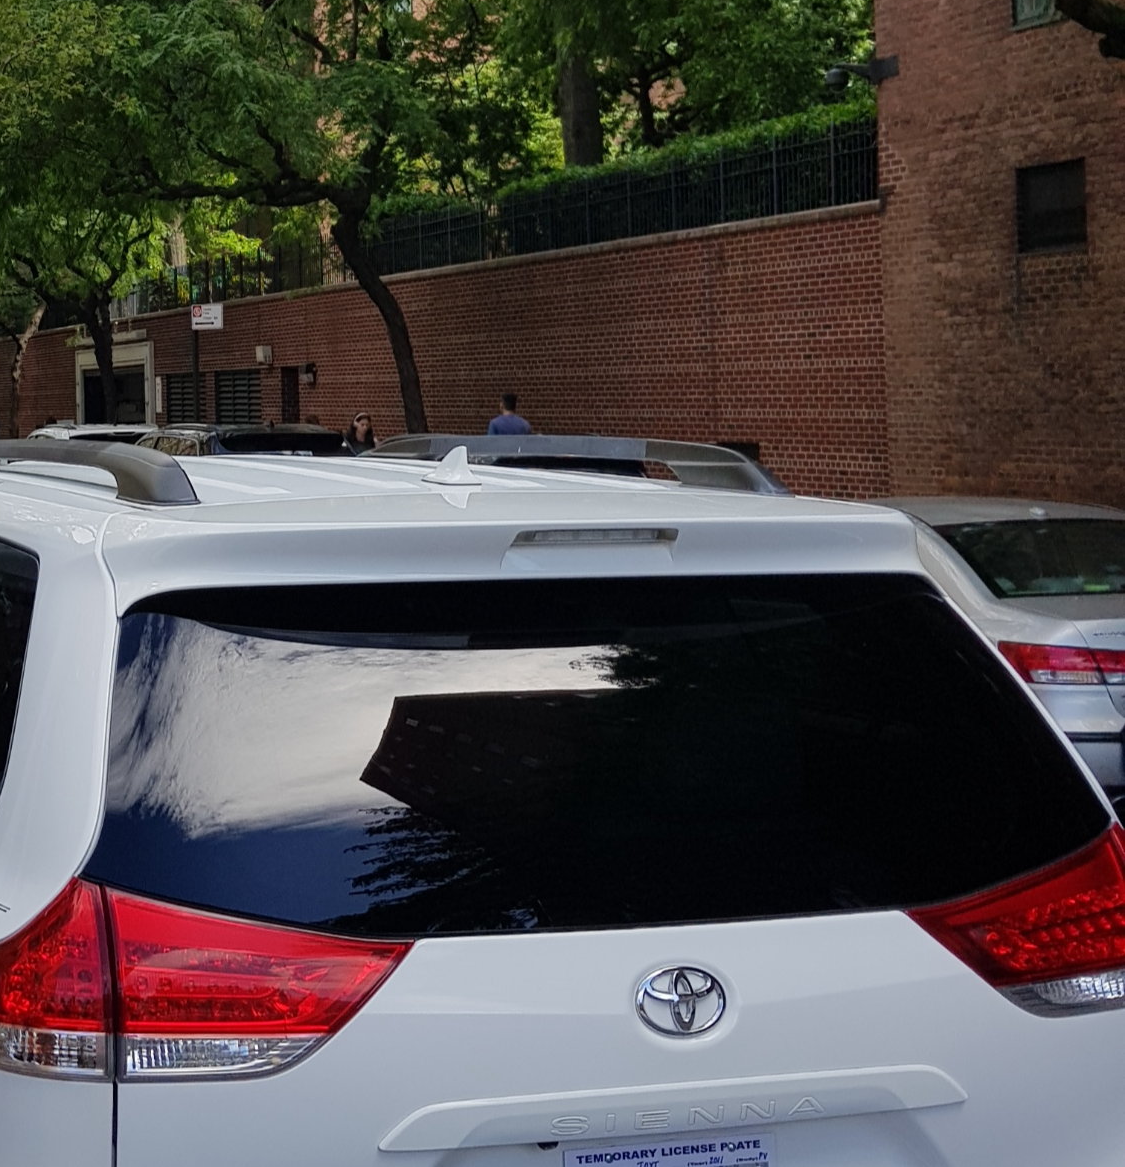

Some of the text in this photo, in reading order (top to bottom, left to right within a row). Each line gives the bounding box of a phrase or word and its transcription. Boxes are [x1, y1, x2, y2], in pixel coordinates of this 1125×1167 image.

[551, 1095, 825, 1137] SIENNA
[661, 1142, 717, 1157] LICENSE
[720, 1139, 761, 1152] PATE
